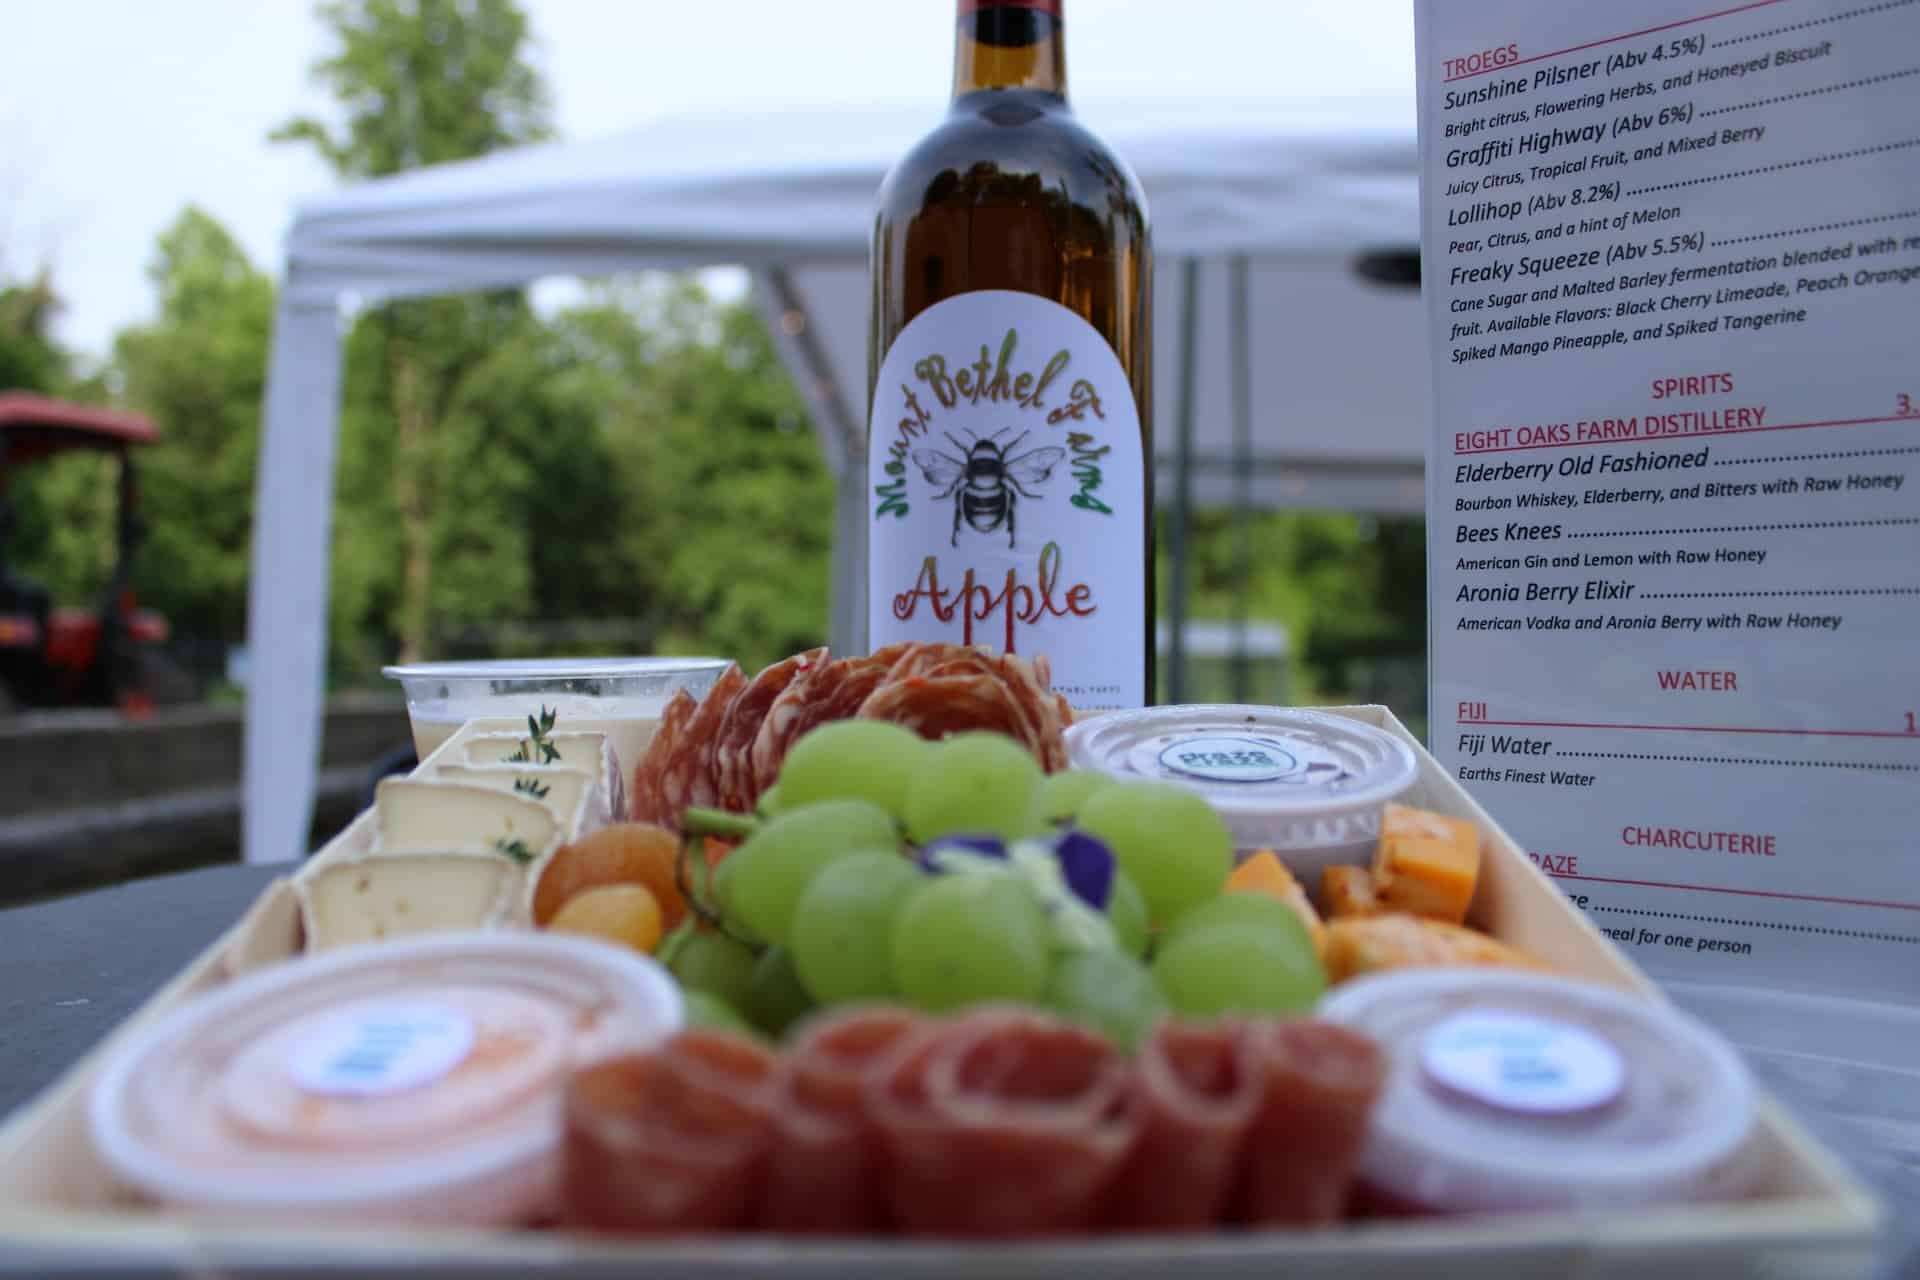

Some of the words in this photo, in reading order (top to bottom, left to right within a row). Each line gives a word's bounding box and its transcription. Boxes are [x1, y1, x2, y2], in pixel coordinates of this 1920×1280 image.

[1443, 44, 1518, 77] TROEGS
[1444, 76, 1527, 111] Sunshine
[1534, 60, 1600, 90] Pilsner
[1605, 52, 1647, 76] (Abv
[1651, 33, 1706, 61] 4.5%)
[1445, 119, 1486, 137] Bright
[1489, 109, 1530, 129] citrus,
[1534, 91, 1605, 120] Flowering
[1609, 79, 1658, 102] Herbs,
[1663, 71, 1692, 91] and
[1697, 56, 1770, 84] Honeyed
[1775, 41, 1832, 67] Biscuit
[1446, 137, 1513, 169] Graffiti
[1518, 123, 1606, 155] Highway
[1612, 115, 1652, 138] (Abv
[1658, 102, 1694, 127] 6%)
[1446, 178, 1479, 196] Juicy
[1482, 169, 1525, 192] Citrus,
[1530, 156, 1586, 182] Tropical
[1591, 147, 1628, 169] Fruit,
[1633, 142, 1663, 161] and
[1667, 132, 1716, 156] Mixed
[1721, 124, 1765, 146] Berry
[1448, 197, 1522, 227] Lollihop
[1527, 190, 1566, 214] (Abv
[1571, 180, 1621, 206] 8.2%)
[1449, 238, 1483, 255] Pear,
[1487, 227, 1530, 250] Citrus,
[1535, 224, 1562, 242] and
[1565, 224, 1575, 237] a
[1579, 216, 1610, 234] hint
[1612, 213, 1629, 232] of
[1632, 204, 1681, 225] Melon
[1450, 257, 1514, 286] Freaky
[1518, 249, 1600, 278] Squeeze
[1606, 241, 1647, 266] (Abv
[1652, 231, 1705, 258] 5.5%)
[1451, 296, 1483, 313] Cane
[1487, 289, 1528, 310] Sugar
[1531, 284, 1558, 303] and
[1562, 278, 1615, 298] Malted
[1619, 271, 1667, 293] Barley
[1670, 255, 1777, 286] fermentation
[1783, 244, 1853, 267] blended
[1857, 237, 1897, 256] with
[1451, 321, 1484, 340] fruit.
[1487, 312, 1551, 333] Available
[1555, 304, 1612, 325] Flavors:
[1616, 297, 1657, 317] Black
[1661, 287, 1712, 313] Cherry
[1715, 281, 1790, 305] Limeade,
[1796, 271, 1849, 293] Peach
[1452, 343, 1496, 364] Spiked
[1500, 337, 1549, 360] Mango
[1553, 329, 1629, 351] Pineapple,
[1632, 324, 1662, 342] and
[1666, 316, 1718, 339] Spiked
[1723, 308, 1806, 331] Tangerine
[1652, 373, 1733, 399] SPIRITS
[876, 383, 932, 520] Mount
[914, 328, 1071, 410] Bethel
[1047, 379, 1113, 515] Farms
[1455, 429, 1512, 450] EIGHT
[1518, 425, 1571, 446] OAKS
[1577, 418, 1637, 442] FARM
[1644, 406, 1765, 435] DISTILLERY
[1455, 459, 1553, 483] Elderberry
[1559, 455, 1593, 476] Old
[1599, 445, 1709, 473] Fashioned
[1455, 496, 1512, 512] Bourbon
[1516, 492, 1579, 509] Whiskey,
[1583, 486, 1665, 505] Elderberry,
[1669, 484, 1700, 500] and
[1704, 481, 1757, 498] Bitters
[1762, 478, 1798, 494] with
[1803, 475, 1841, 493] Raw
[1846, 473, 1904, 492] Honey
[1456, 524, 1498, 543] Bees
[1504, 522, 1562, 541] Knees
[1456, 554, 1518, 570] American
[1524, 554, 1548, 568] Gin
[1552, 553, 1579, 567] and
[1583, 551, 1633, 566] Lemon
[1637, 549, 1671, 565] with
[1676, 548, 1710, 564] Raw
[1715, 547, 1766, 567] Honey
[893, 541, 1097, 654] Apple
[1456, 583, 1519, 601] Aronia
[1525, 583, 1579, 605] Berry
[1585, 581, 1635, 599] Elixir
[1457, 616, 1521, 630] American
[1526, 616, 1571, 630] Vodka
[1575, 615, 1602, 629] and
[1606, 615, 1656, 630] Aronia
[1661, 615, 1702, 632] Berry
[1706, 614, 1741, 629] with
[1747, 614, 1782, 628] Raw
[1786, 613, 1842, 632] Honey
[1657, 671, 1737, 691] WATER
[1458, 702, 1486, 721] FIJI
[1458, 734, 1486, 754] Fiji
[1491, 737, 1552, 756] Water
[1459, 766, 1501, 782] Earths
[1504, 769, 1546, 784] Finest
[1550, 771, 1596, 787] Water
[1622, 826, 1776, 856] CHARCUTERIE
[1637, 929, 1662, 945] for
[1664, 935, 1694, 948] one
[1696, 938, 1752, 955] person
